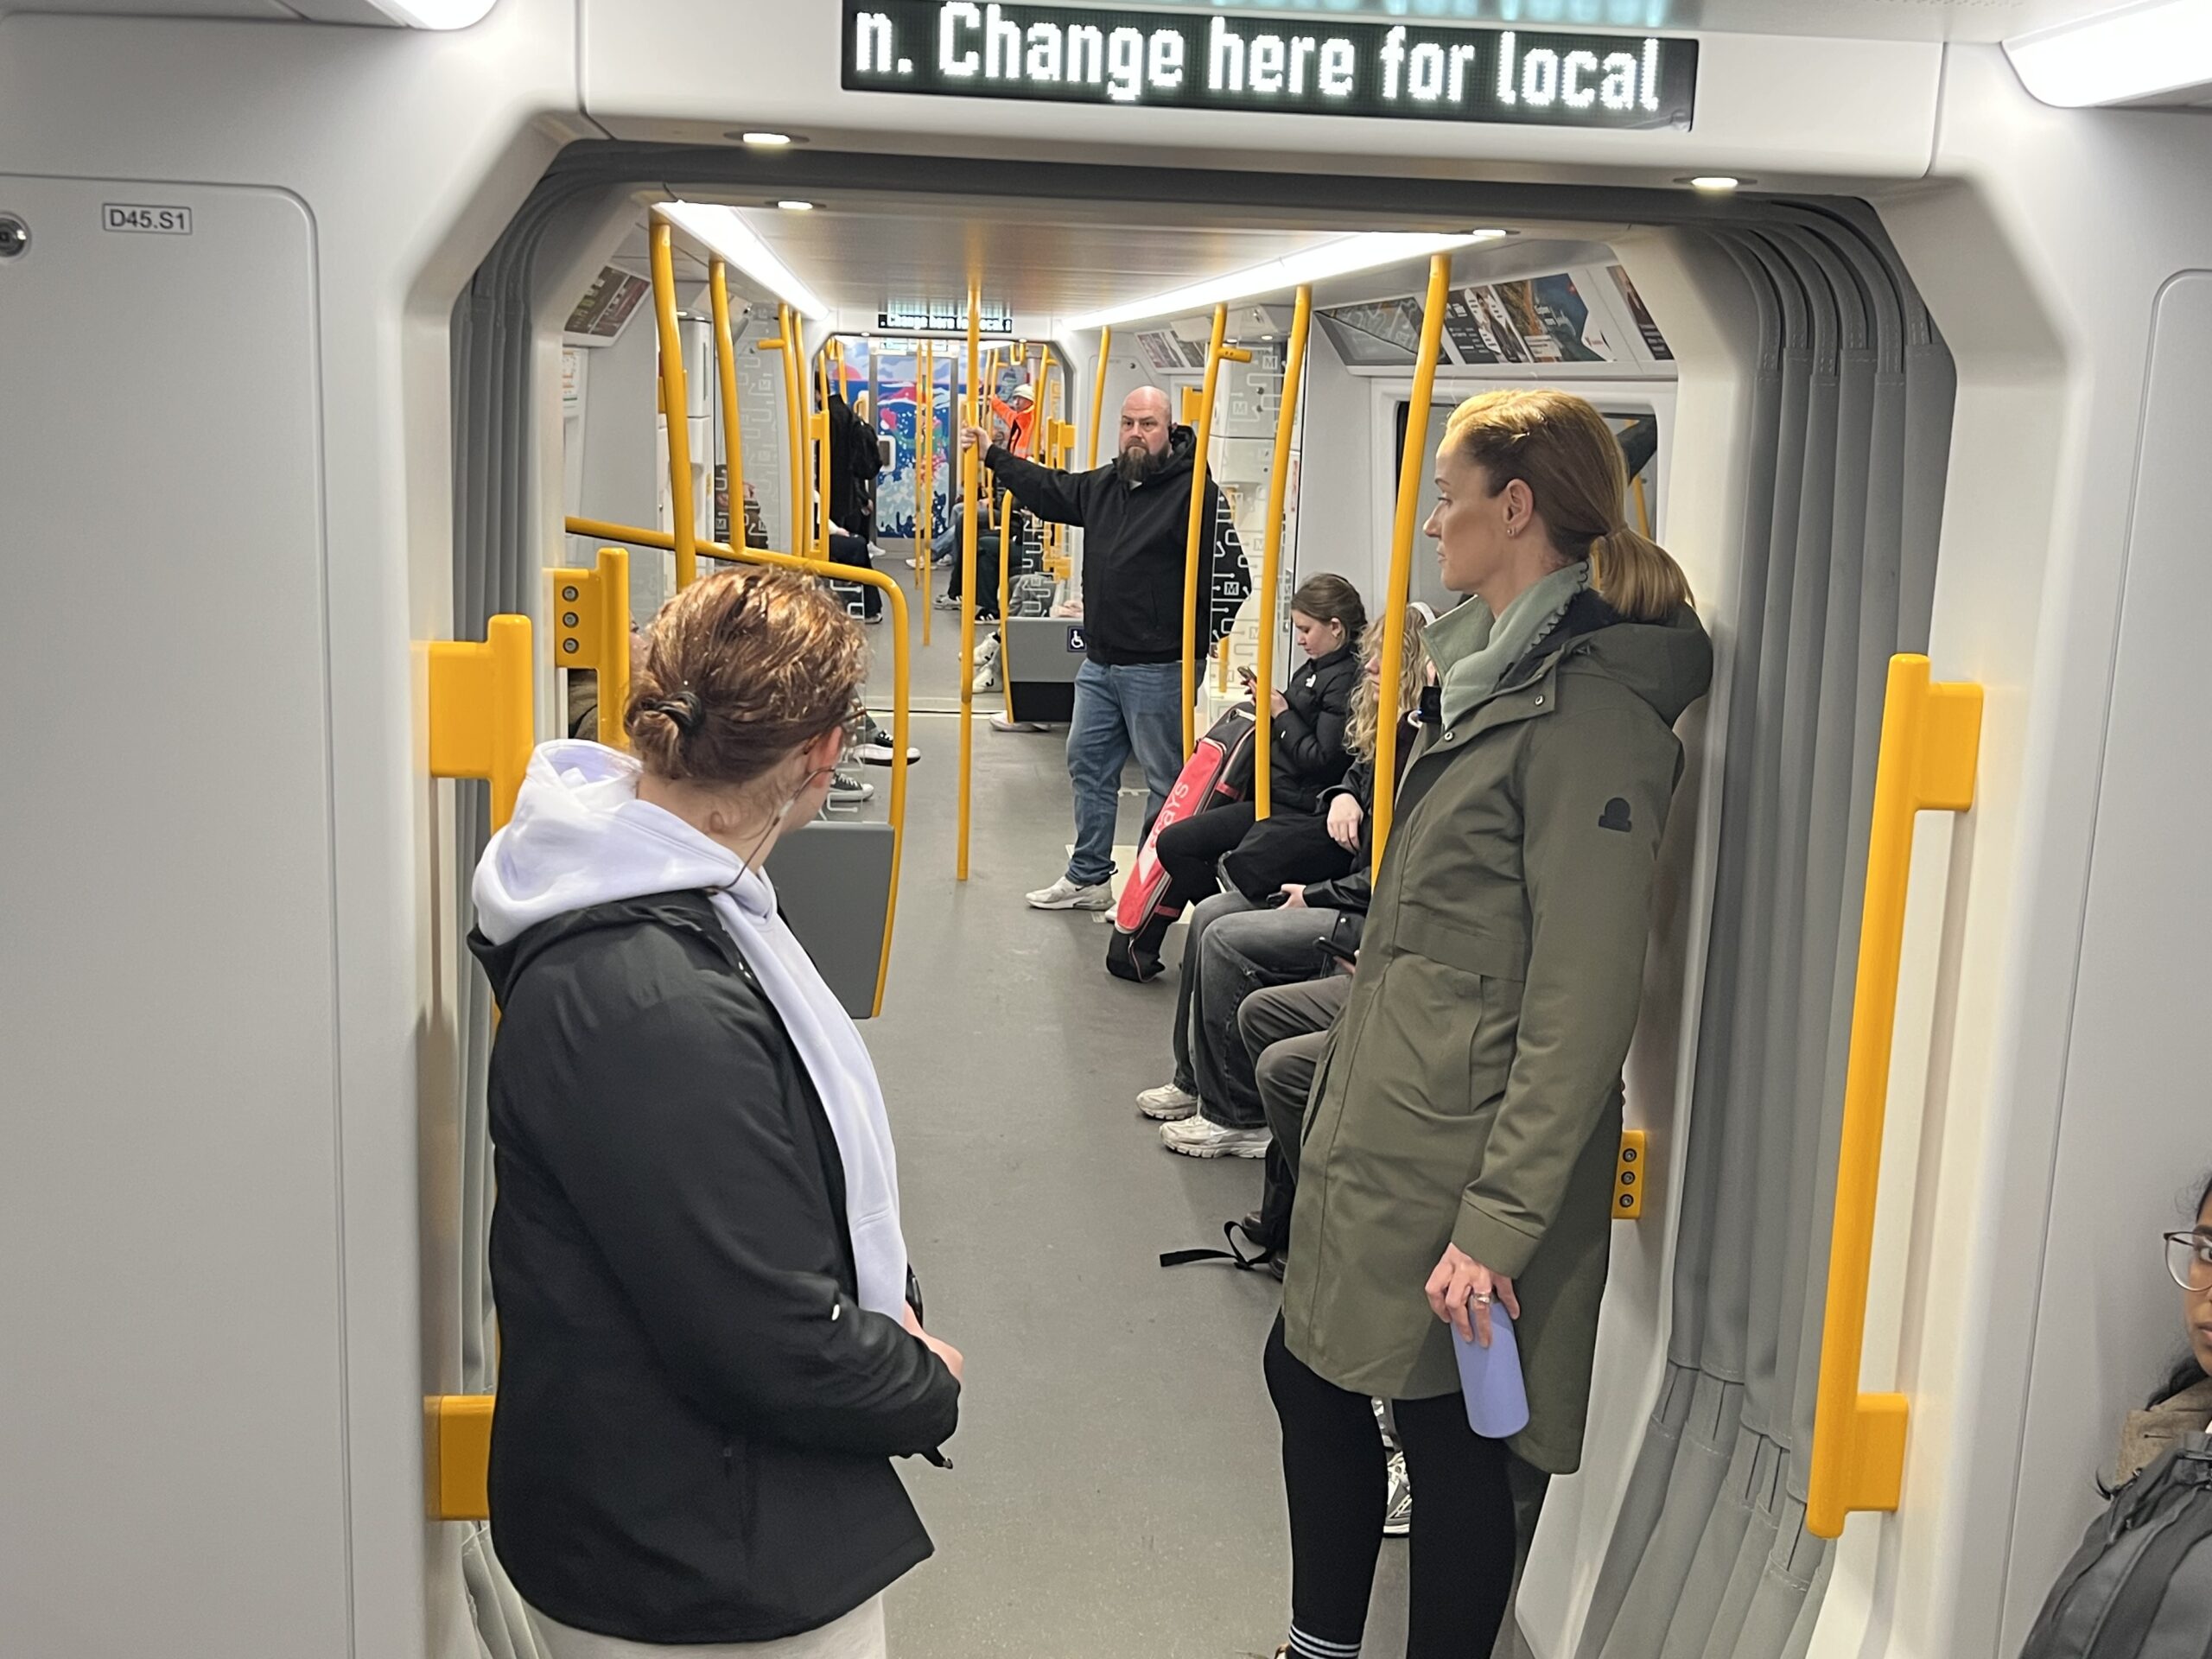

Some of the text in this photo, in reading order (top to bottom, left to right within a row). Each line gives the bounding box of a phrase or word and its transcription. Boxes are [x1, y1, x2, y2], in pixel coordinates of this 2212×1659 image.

[856, 2, 1659, 111] n. Change here for local
[110, 209, 185, 230] D45.S1
[1225, 583, 1238, 594] M
